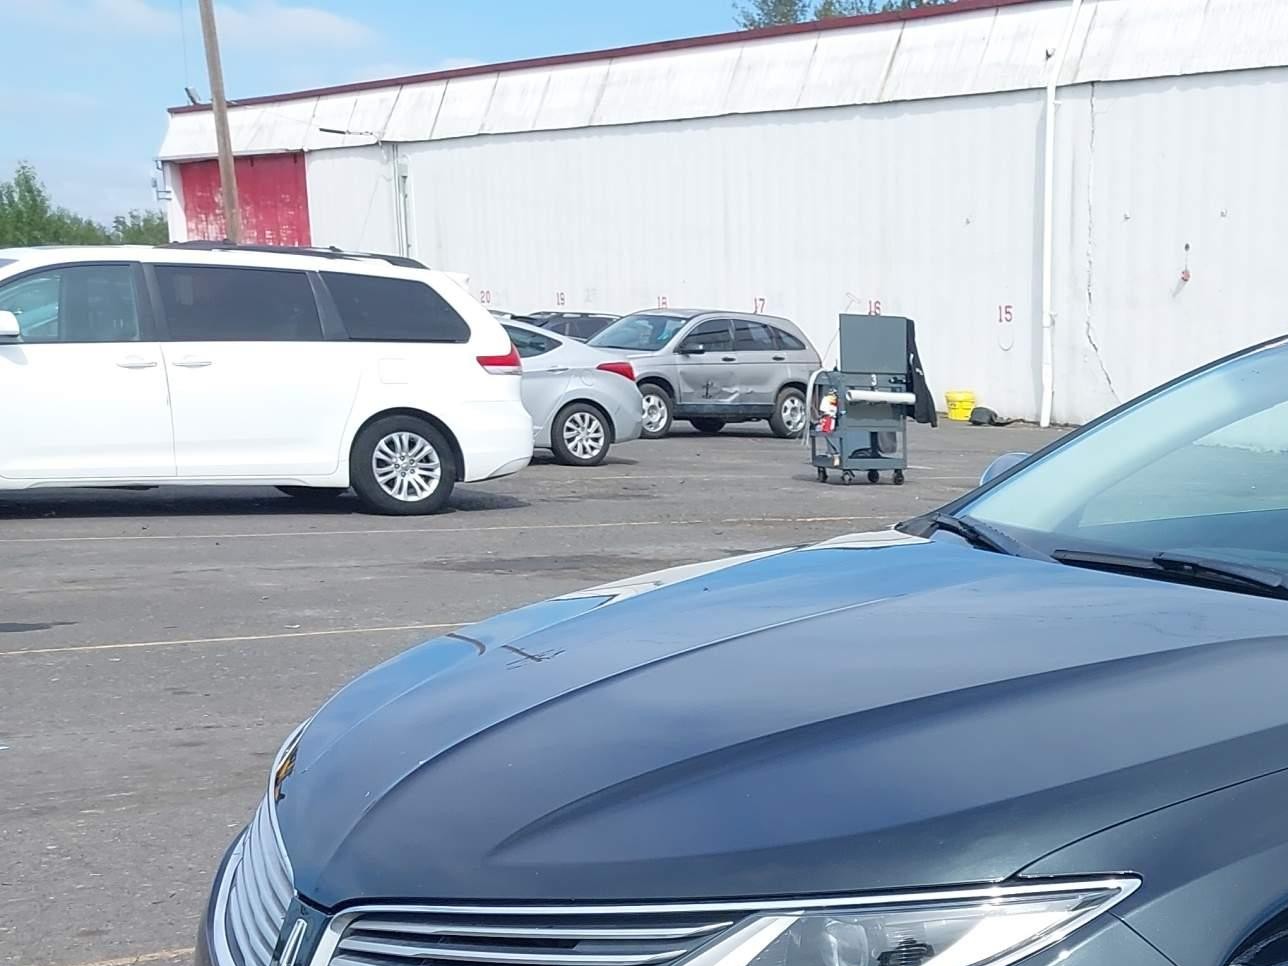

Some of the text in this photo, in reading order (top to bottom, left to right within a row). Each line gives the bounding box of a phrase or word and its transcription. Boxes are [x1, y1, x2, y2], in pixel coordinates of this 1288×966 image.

[753, 297, 765, 314] 17
[868, 300, 880, 316] 16
[998, 305, 1013, 323] 15
[871, 373, 877, 386] 3
